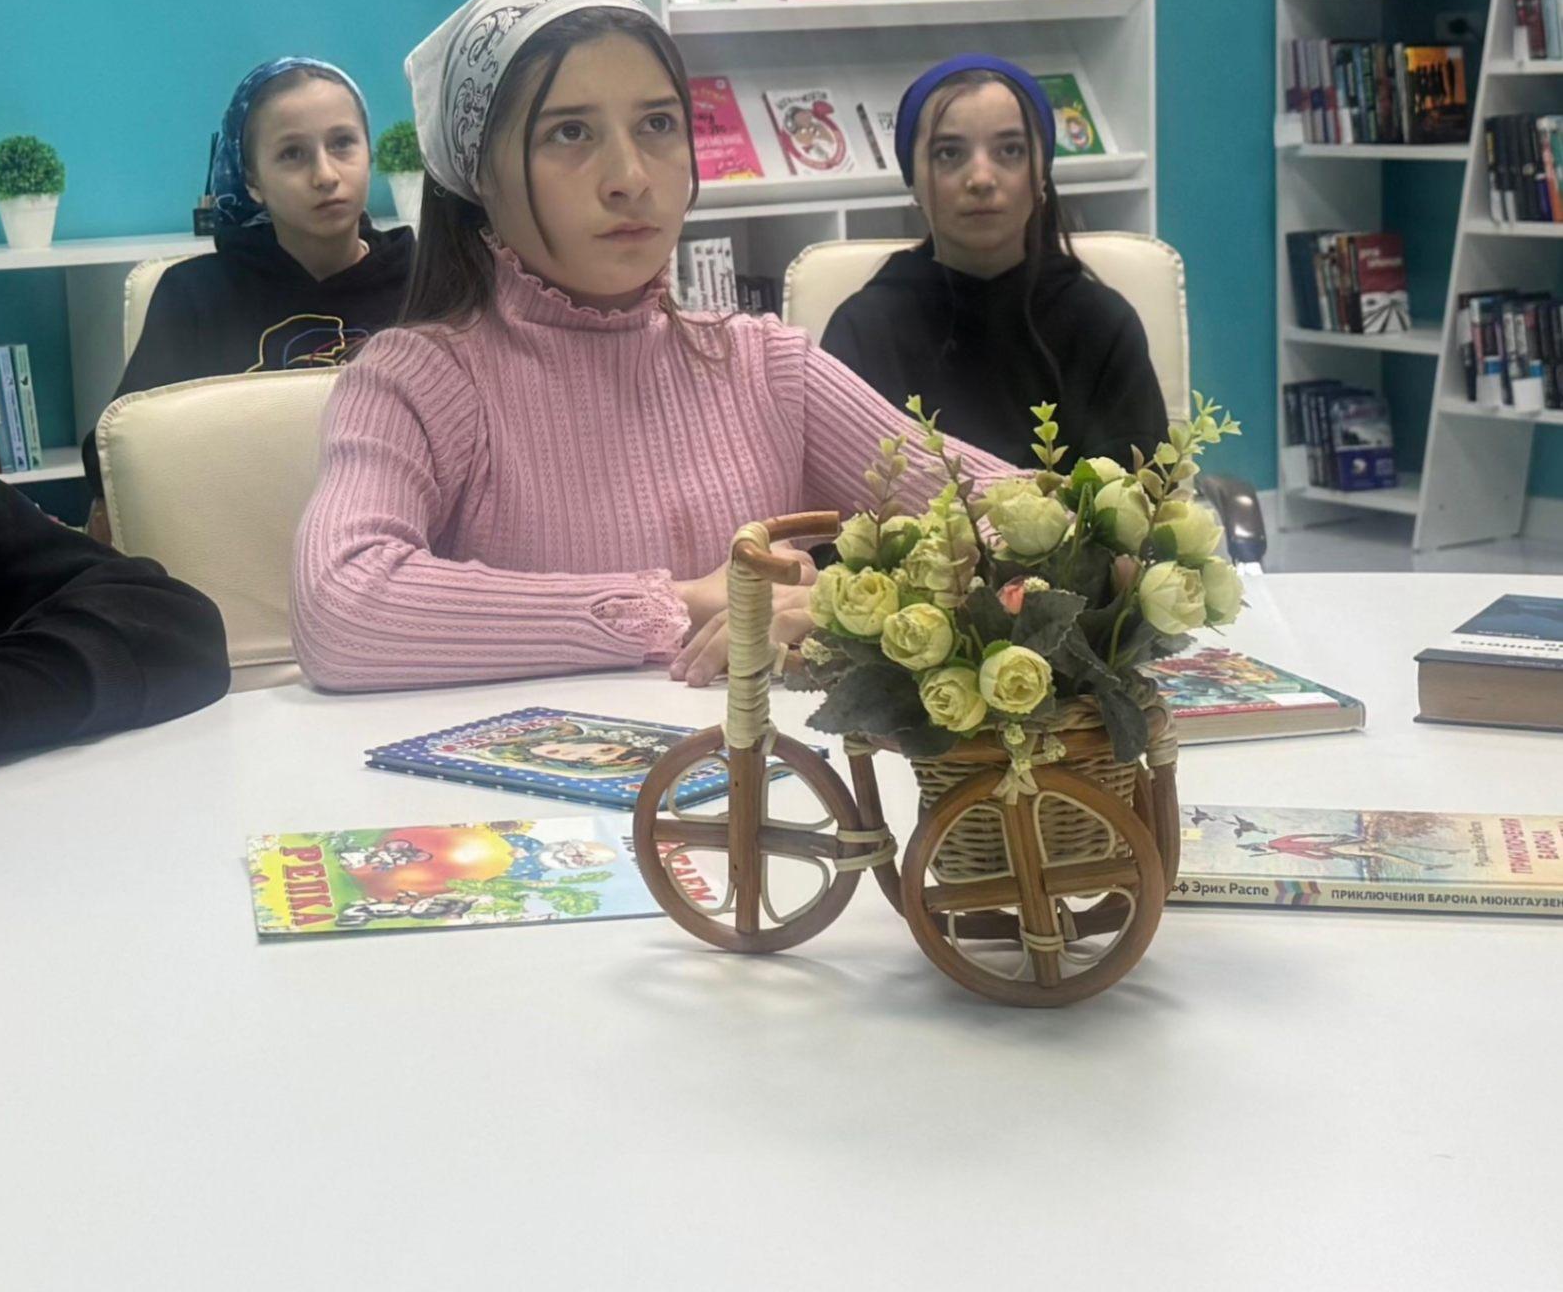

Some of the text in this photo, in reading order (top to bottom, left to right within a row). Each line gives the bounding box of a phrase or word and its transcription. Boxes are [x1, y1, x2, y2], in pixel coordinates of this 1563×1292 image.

[279, 846, 339, 927] РЕПКА
[1191, 880, 1227, 896] Эрих
[1229, 882, 1270, 896] Распе
[1331, 889, 1425, 903] ПРИКЛЮЧЕНИЯ
[1427, 892, 1478, 905] БАРОНА
